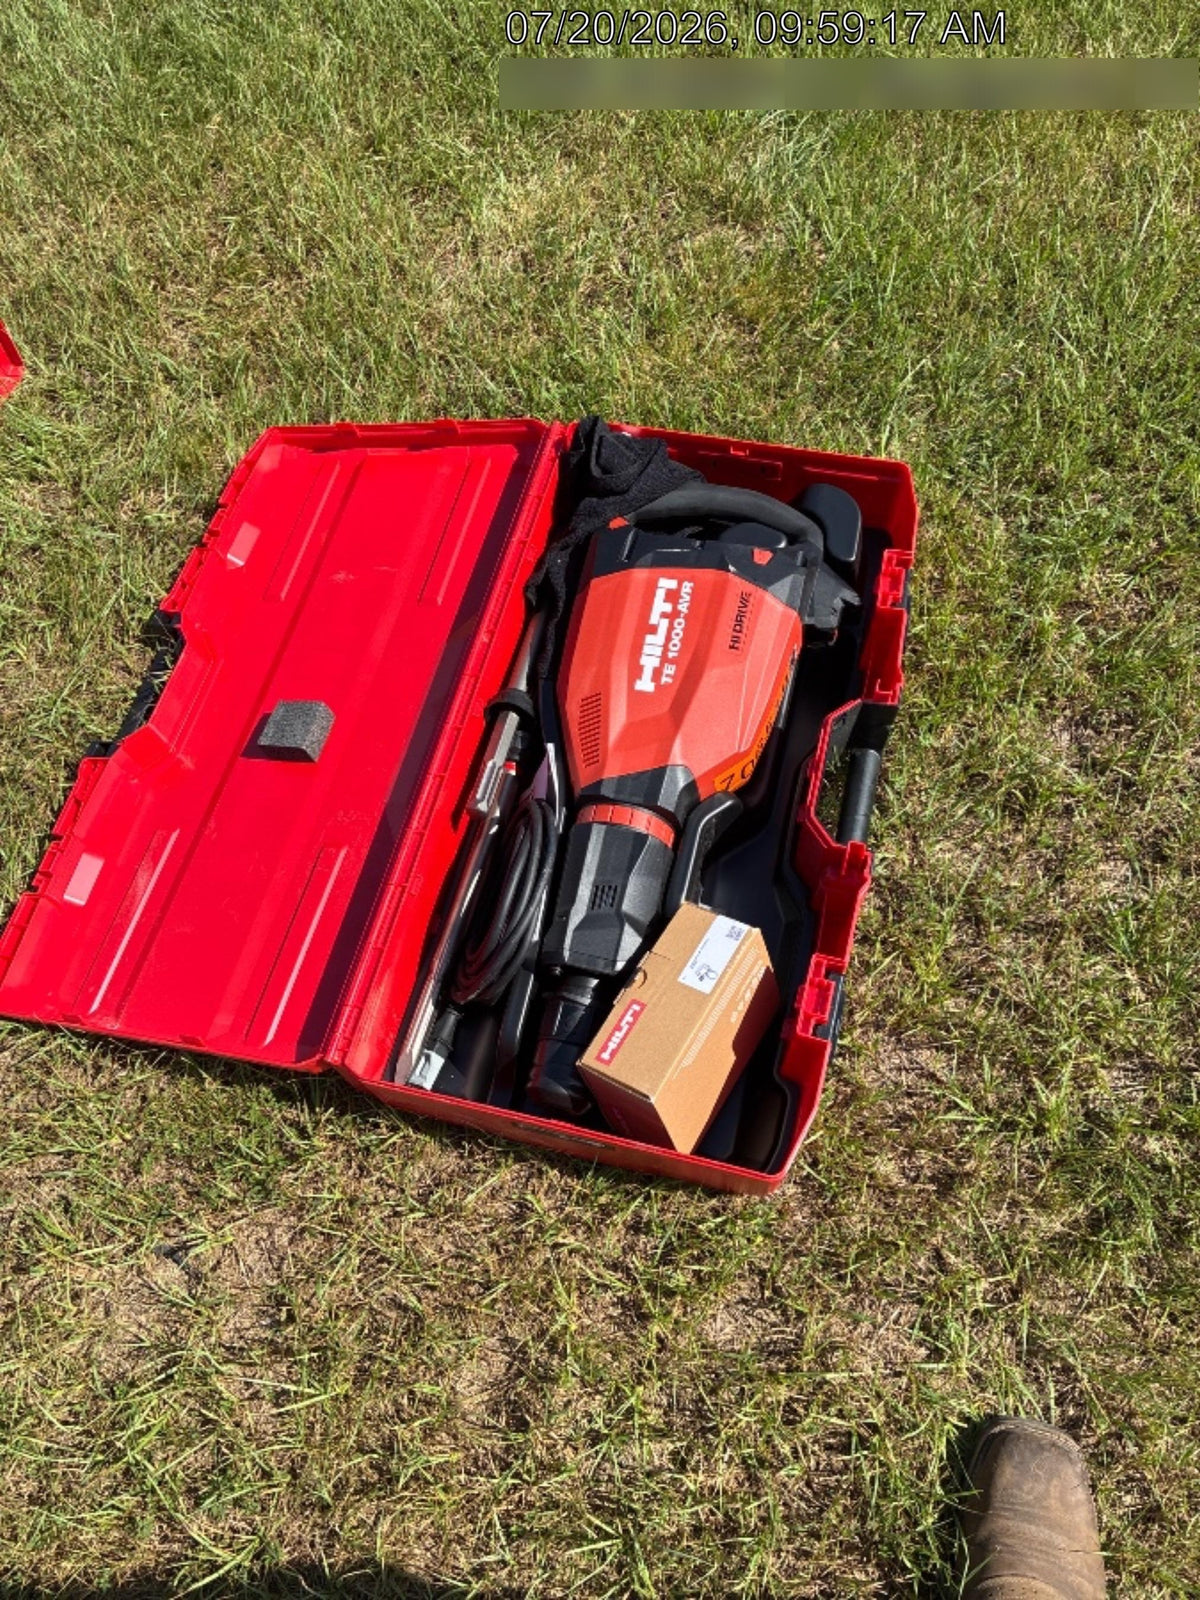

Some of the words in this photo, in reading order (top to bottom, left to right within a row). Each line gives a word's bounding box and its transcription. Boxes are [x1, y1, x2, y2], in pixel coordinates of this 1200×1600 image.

[634, 577, 678, 693] HILTI
[667, 580, 695, 659] 1000-AVR
[731, 590, 753, 635] DRIVE
[728, 634, 742, 652] HI
[660, 661, 677, 686] TE
[600, 1002, 642, 1062] HILTI
